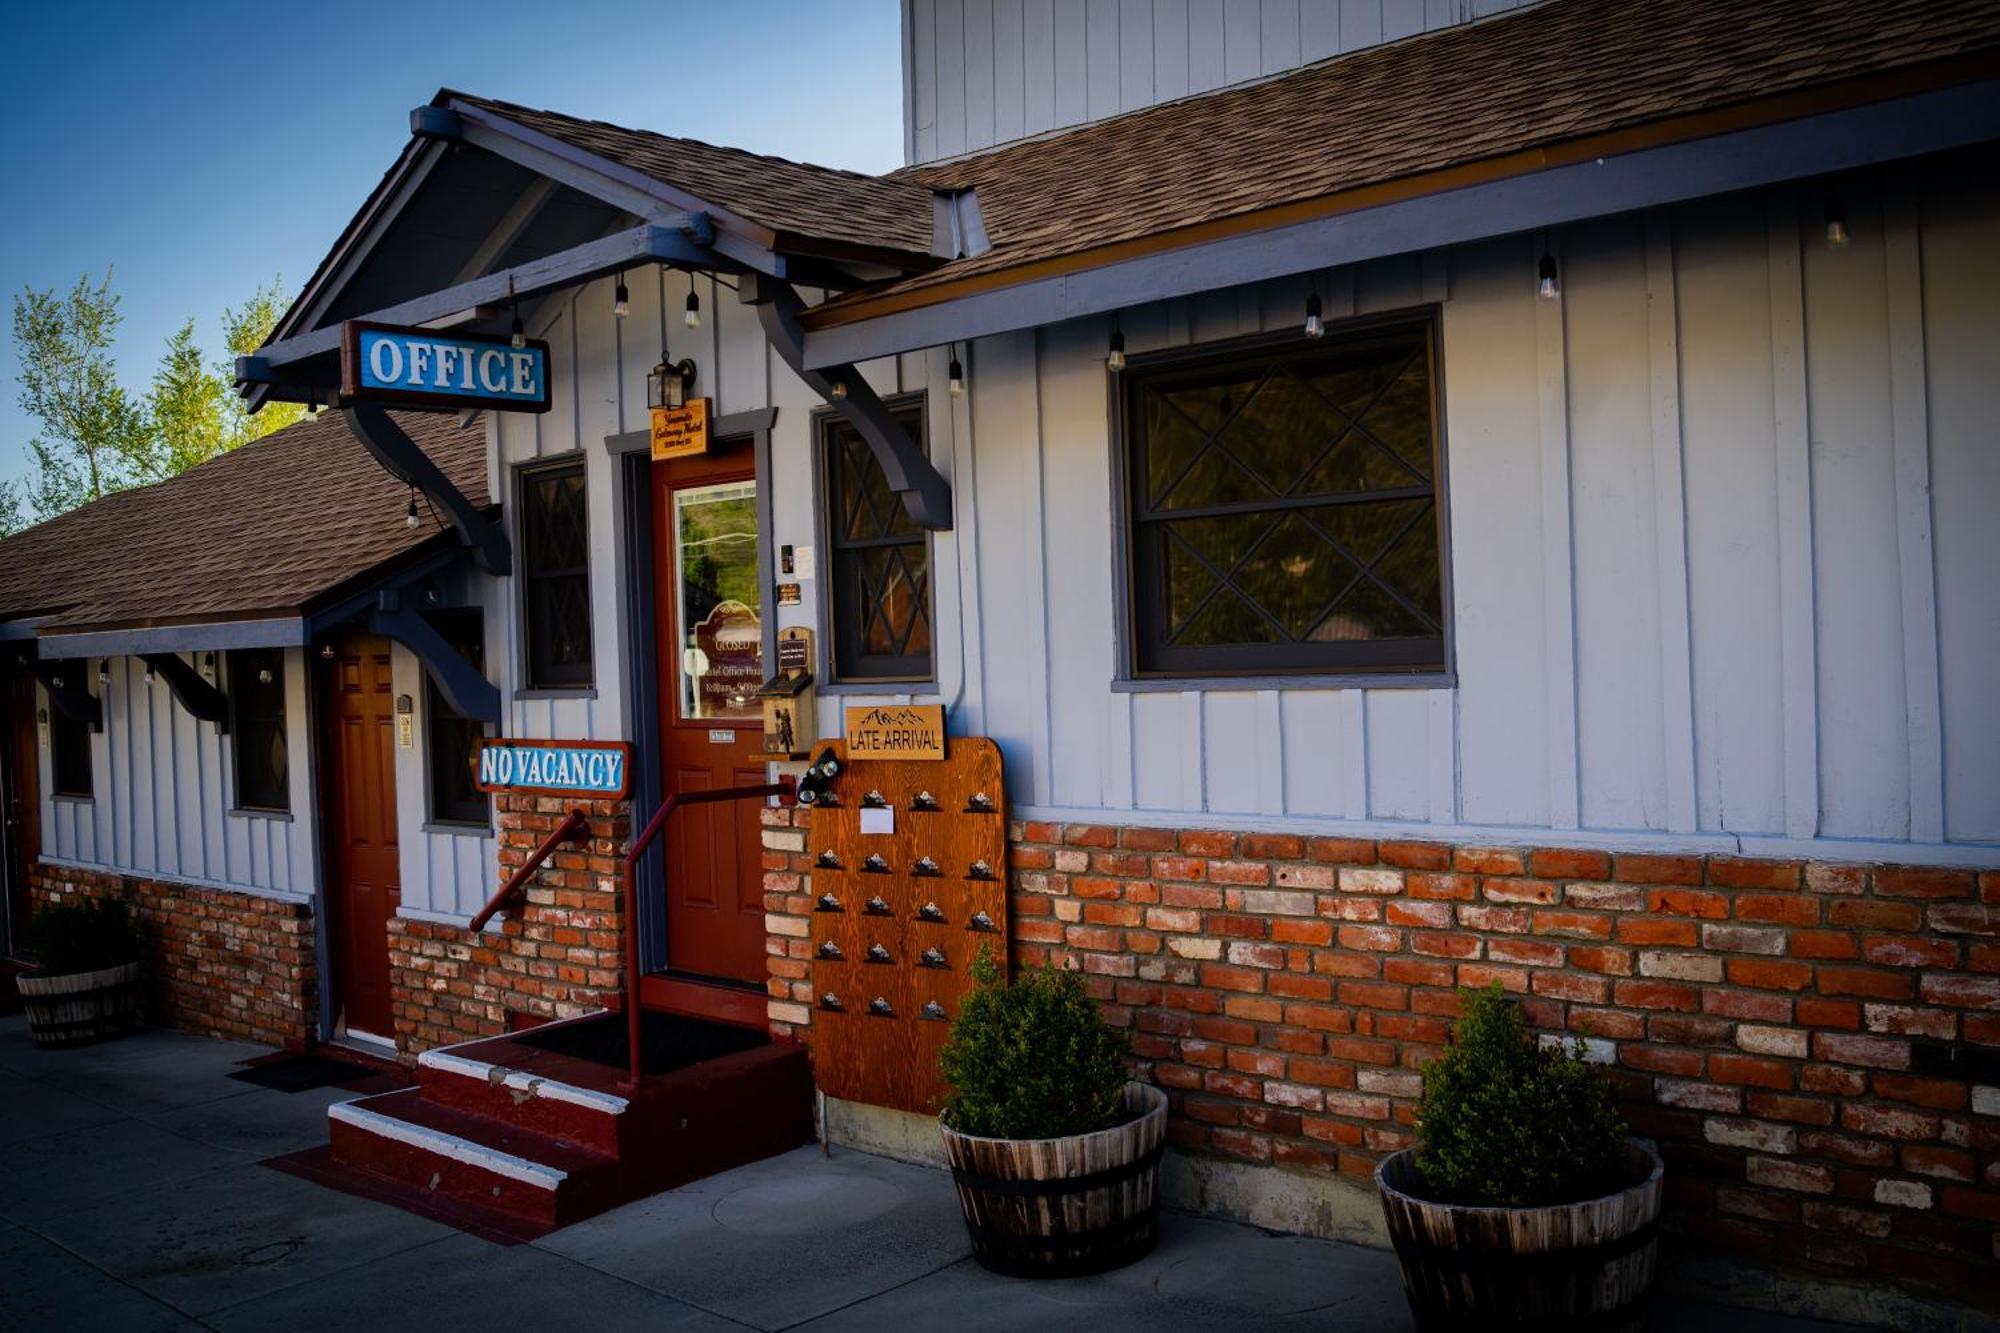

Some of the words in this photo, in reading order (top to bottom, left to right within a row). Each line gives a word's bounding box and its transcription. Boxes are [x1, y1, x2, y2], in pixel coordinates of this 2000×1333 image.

[370, 338, 536, 395] OFFICE
[715, 640, 750, 652] CLOSED
[850, 729, 880, 750] LATE
[883, 729, 939, 750] ARRIVAL
[481, 747, 513, 784] NO
[515, 750, 621, 787] VACANCY
